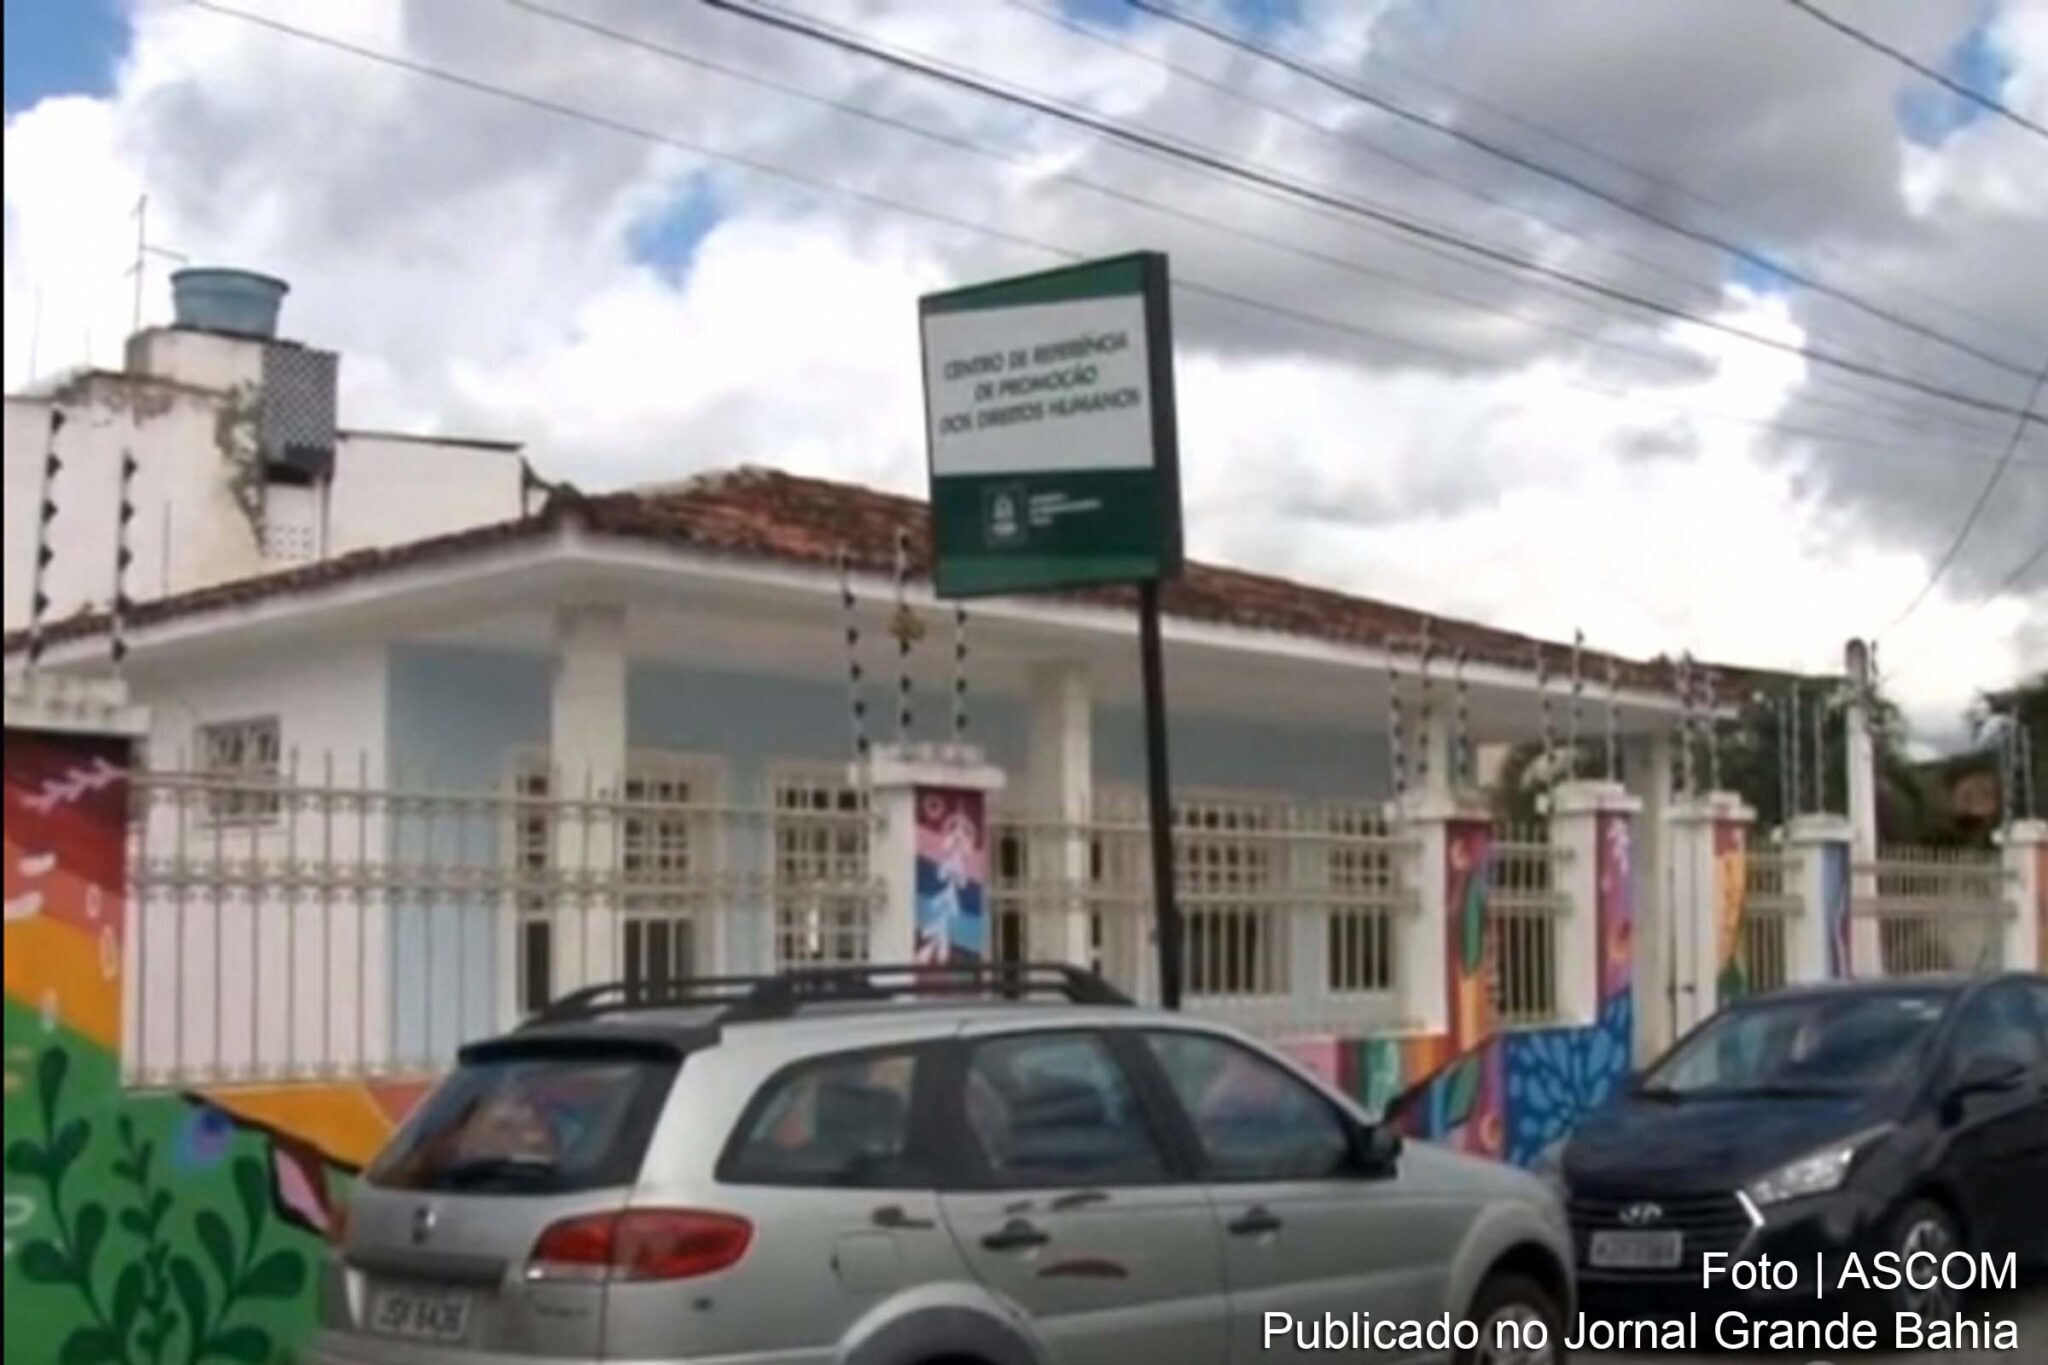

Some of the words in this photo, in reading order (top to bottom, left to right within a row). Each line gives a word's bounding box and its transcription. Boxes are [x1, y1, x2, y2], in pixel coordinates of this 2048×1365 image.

[944, 352, 1004, 380] CENTRO
[1008, 349, 1028, 369] DE
[974, 382, 993, 402] DE
[998, 363, 1098, 397] PROMOÇÃO
[940, 413, 972, 435] DOS
[977, 400, 1043, 428] DIREITOS
[1049, 386, 1141, 413] HUMANOS
